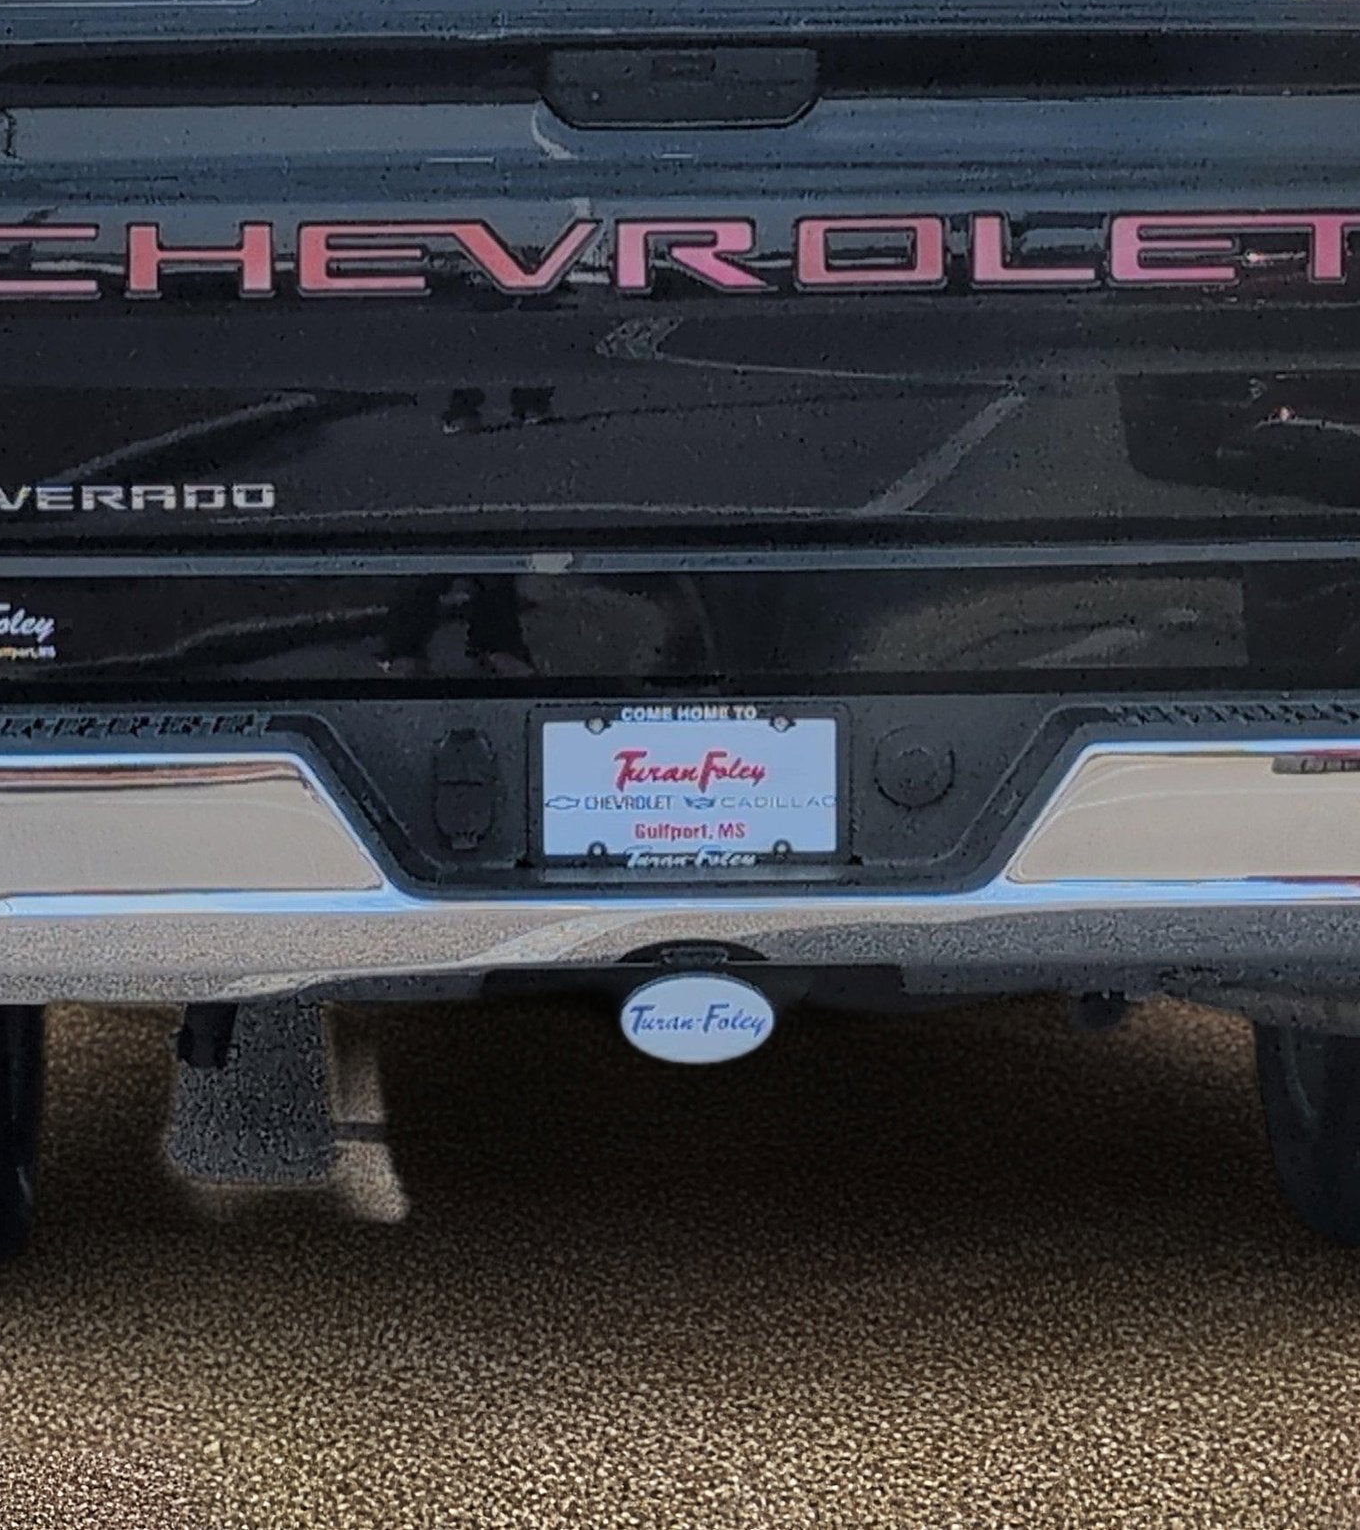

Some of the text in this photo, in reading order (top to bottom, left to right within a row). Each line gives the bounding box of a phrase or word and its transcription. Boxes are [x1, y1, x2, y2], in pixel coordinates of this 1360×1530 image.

[621, 706, 758, 721] COME HOME TO
[584, 795, 837, 810] CHEVROLET CADILLAC
[718, 822, 746, 839] MS
